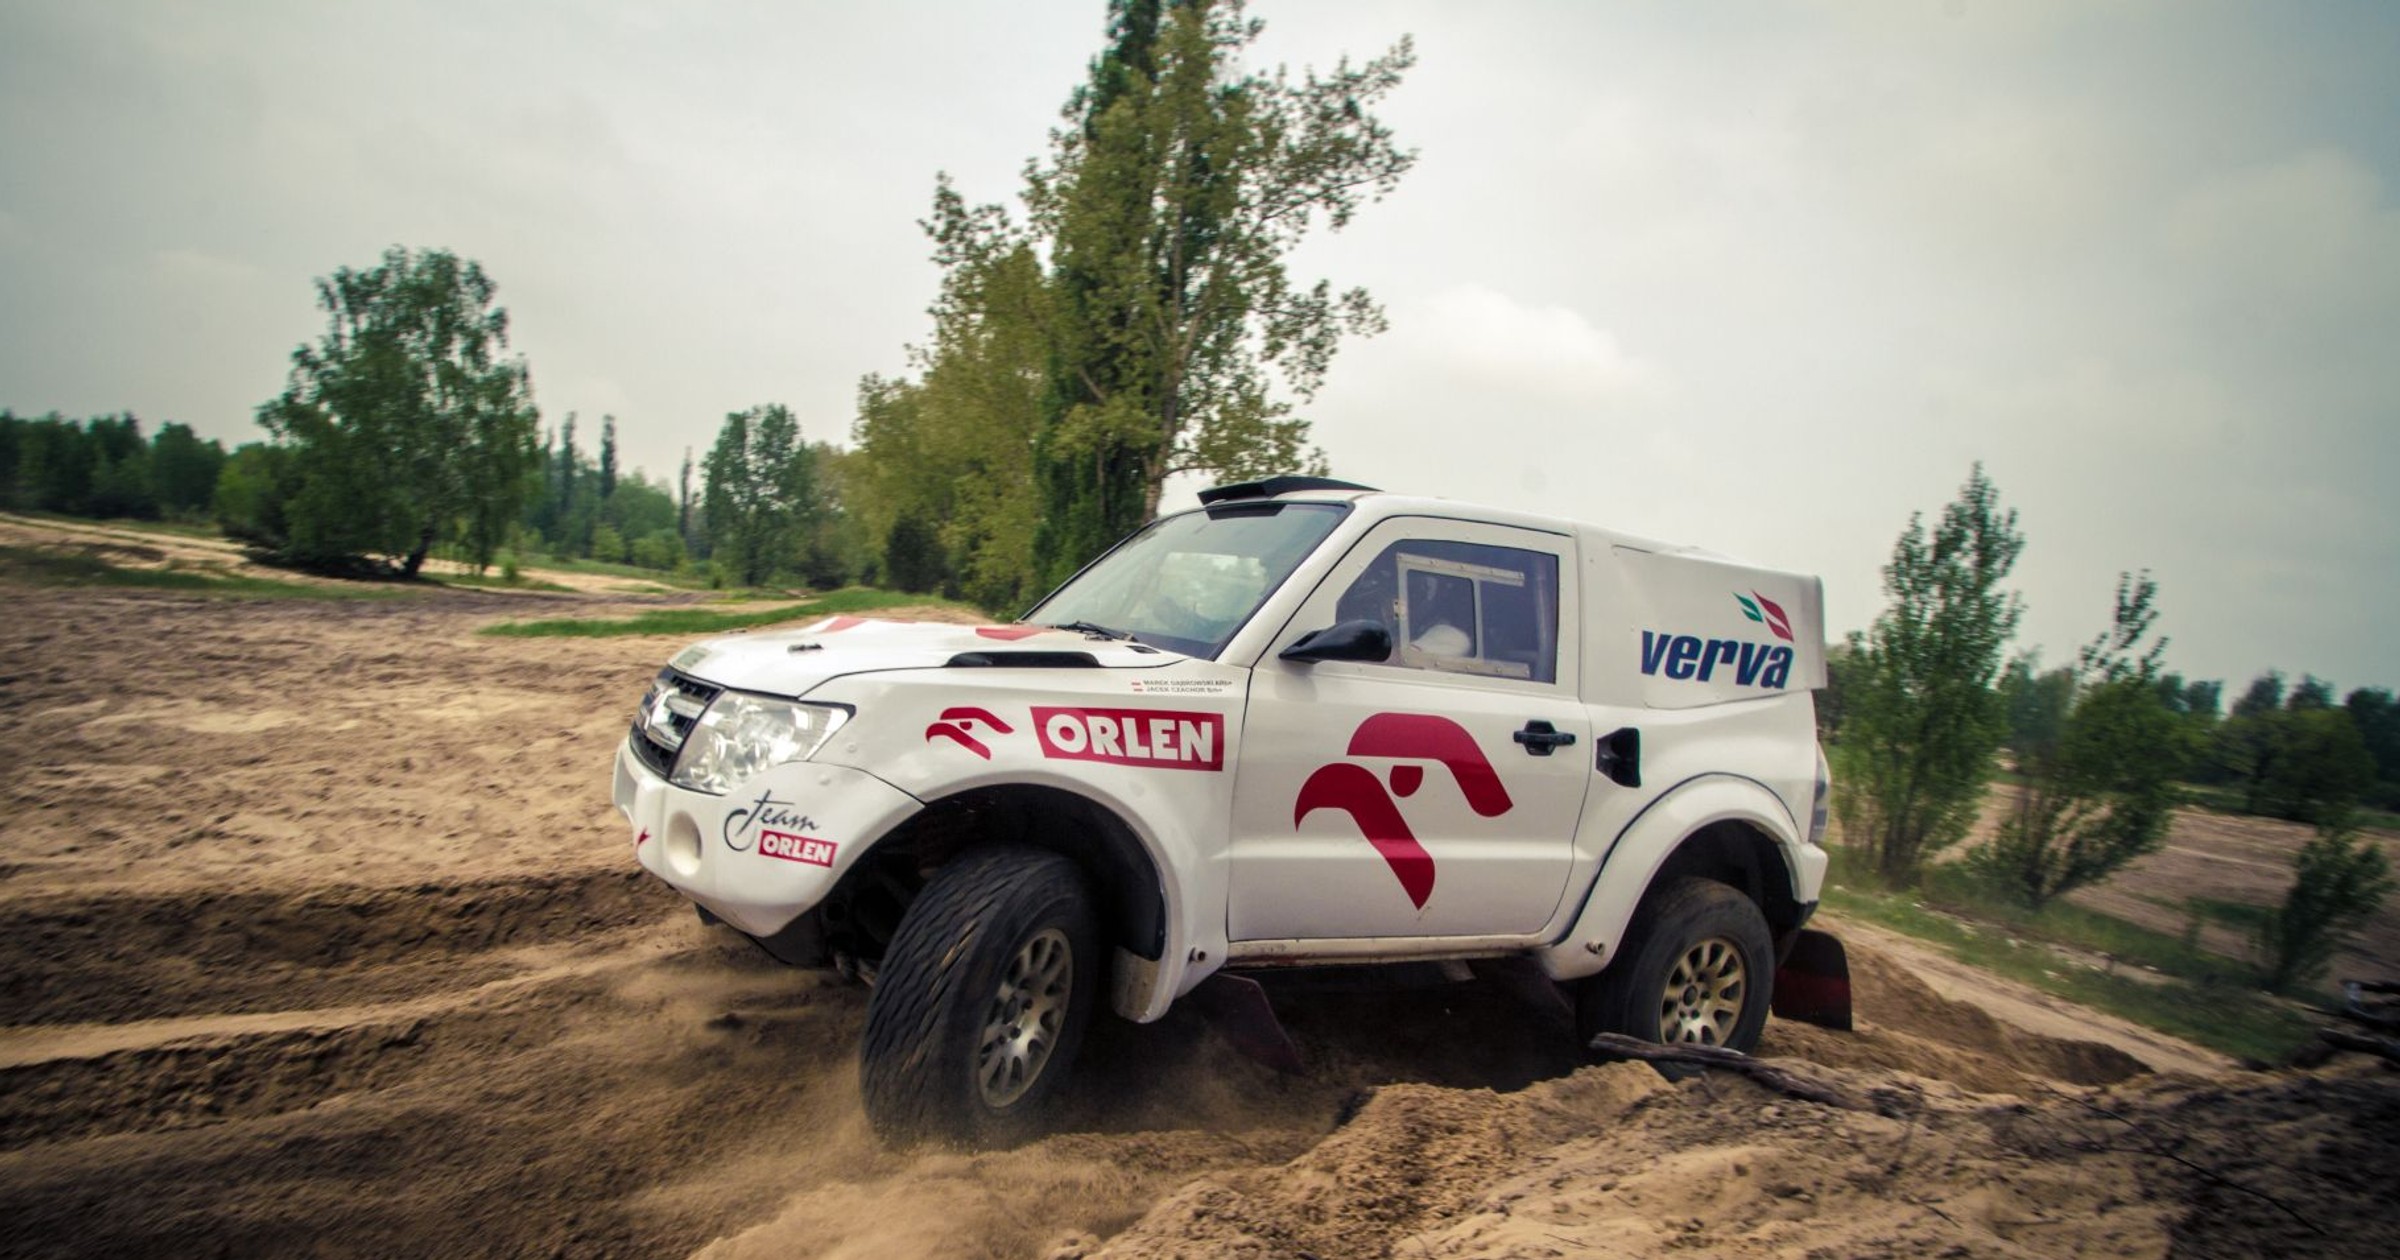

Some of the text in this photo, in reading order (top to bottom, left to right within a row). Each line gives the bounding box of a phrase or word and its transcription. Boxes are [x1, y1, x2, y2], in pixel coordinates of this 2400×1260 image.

[1641, 629, 1794, 689] verva
[1046, 713, 1213, 762] ORLEN
[763, 835, 831, 863] ORLEN
